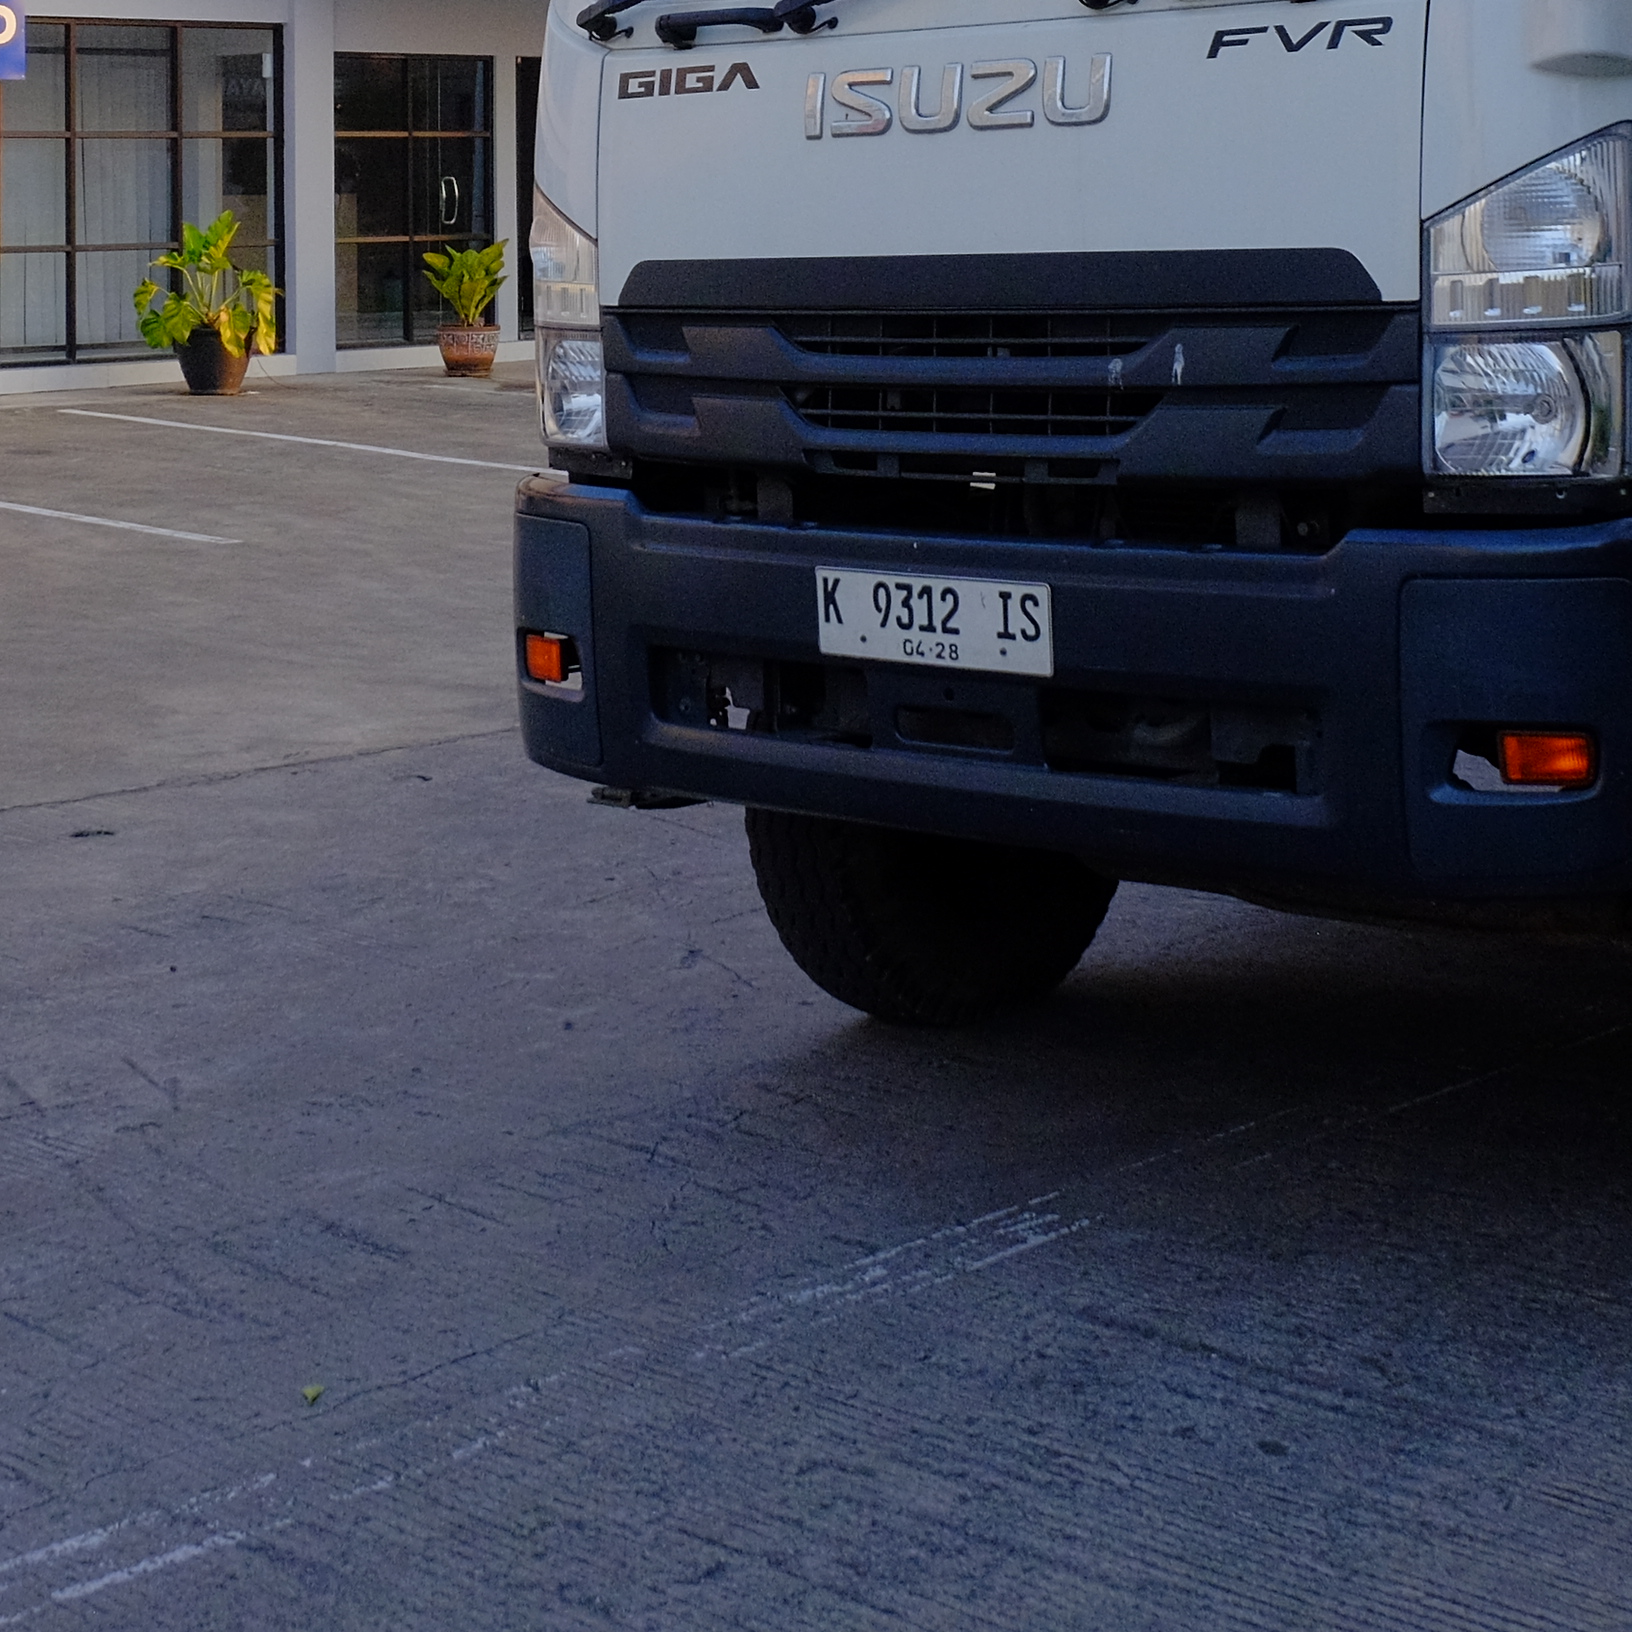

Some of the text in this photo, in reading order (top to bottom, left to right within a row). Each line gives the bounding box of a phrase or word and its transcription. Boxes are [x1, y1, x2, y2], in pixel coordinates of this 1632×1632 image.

[1206, 15, 1393, 60] FVR
[617, 61, 761, 101] GIGA
[804, 52, 1113, 141] ISUZU
[821, 575, 1042, 643] K 9312 IS
